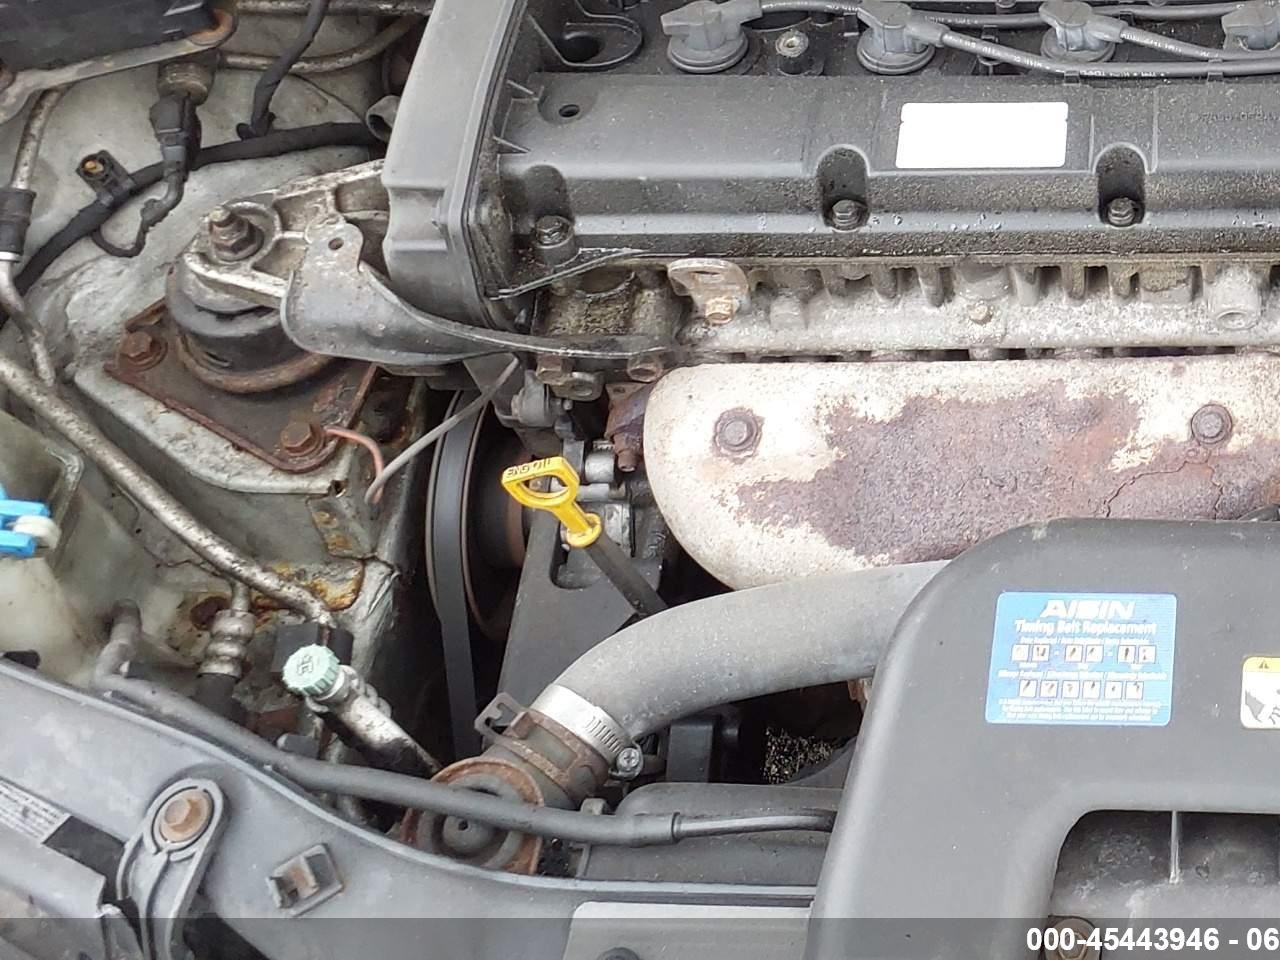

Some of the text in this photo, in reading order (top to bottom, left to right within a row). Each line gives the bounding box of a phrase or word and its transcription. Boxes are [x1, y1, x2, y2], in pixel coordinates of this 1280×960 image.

[1040, 599, 1136, 619] AISIN
[1014, 620, 1157, 636] Timing Belt Replacement
